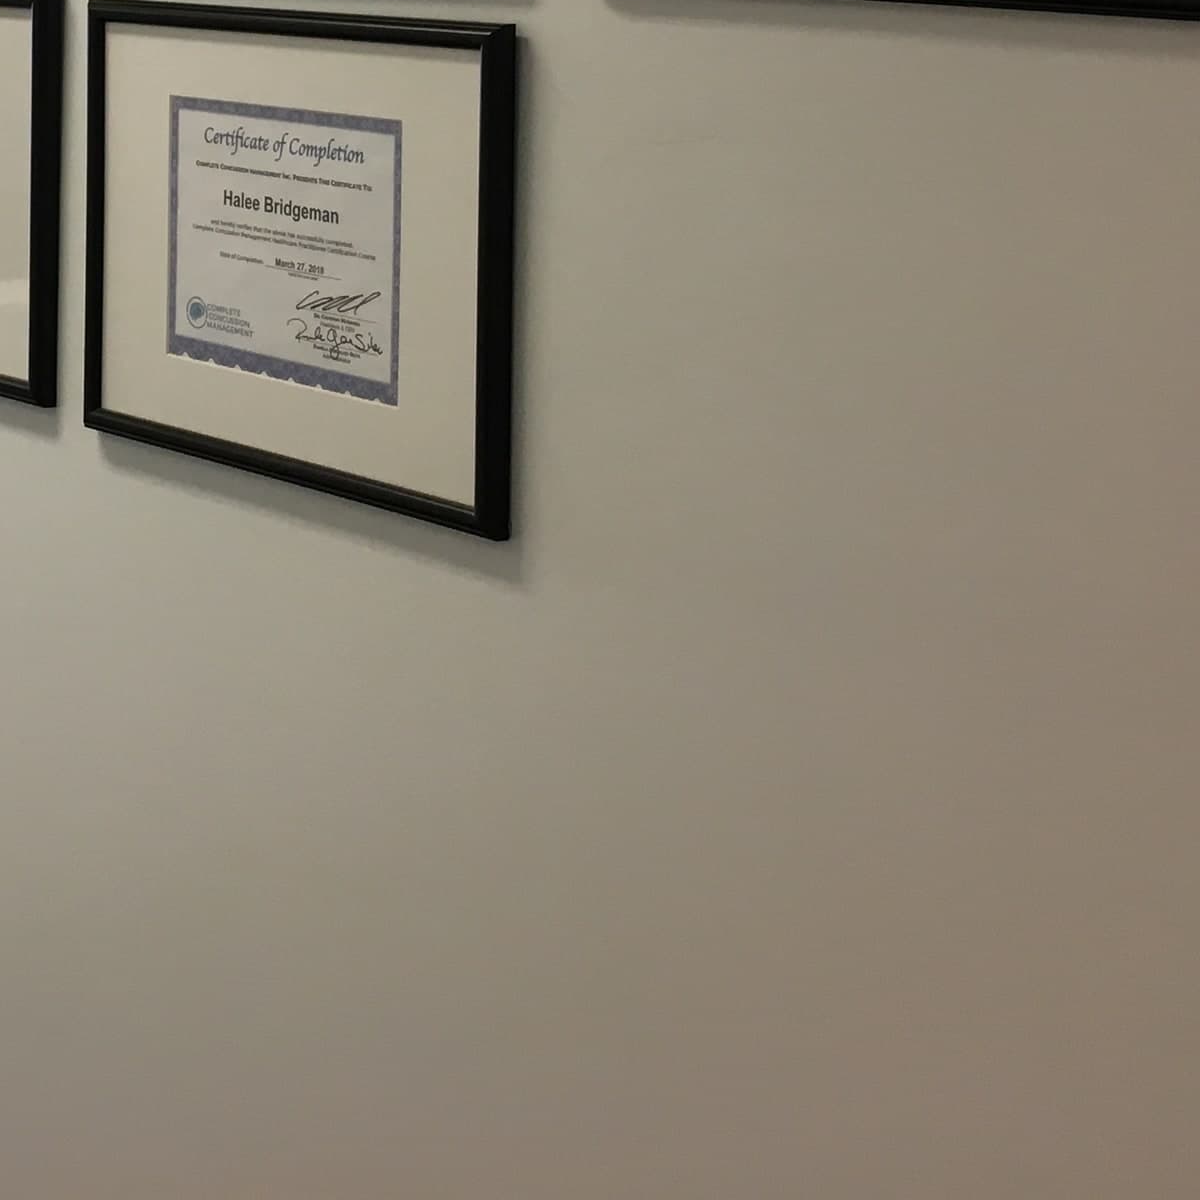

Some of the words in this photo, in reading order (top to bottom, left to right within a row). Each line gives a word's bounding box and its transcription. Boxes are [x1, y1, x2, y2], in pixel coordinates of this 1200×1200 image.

[204, 127, 269, 155] Certificate
[273, 133, 290, 161] of
[289, 138, 364, 166] Completion
[224, 190, 260, 211] Halee
[264, 196, 339, 224] Bridgeman
[275, 258, 295, 269] March
[297, 262, 307, 272] 27,
[207, 304, 240, 317] COMPLETE
[206, 319, 254, 338] MANAGEMENT
[208, 312, 250, 328] CONCUSSION
